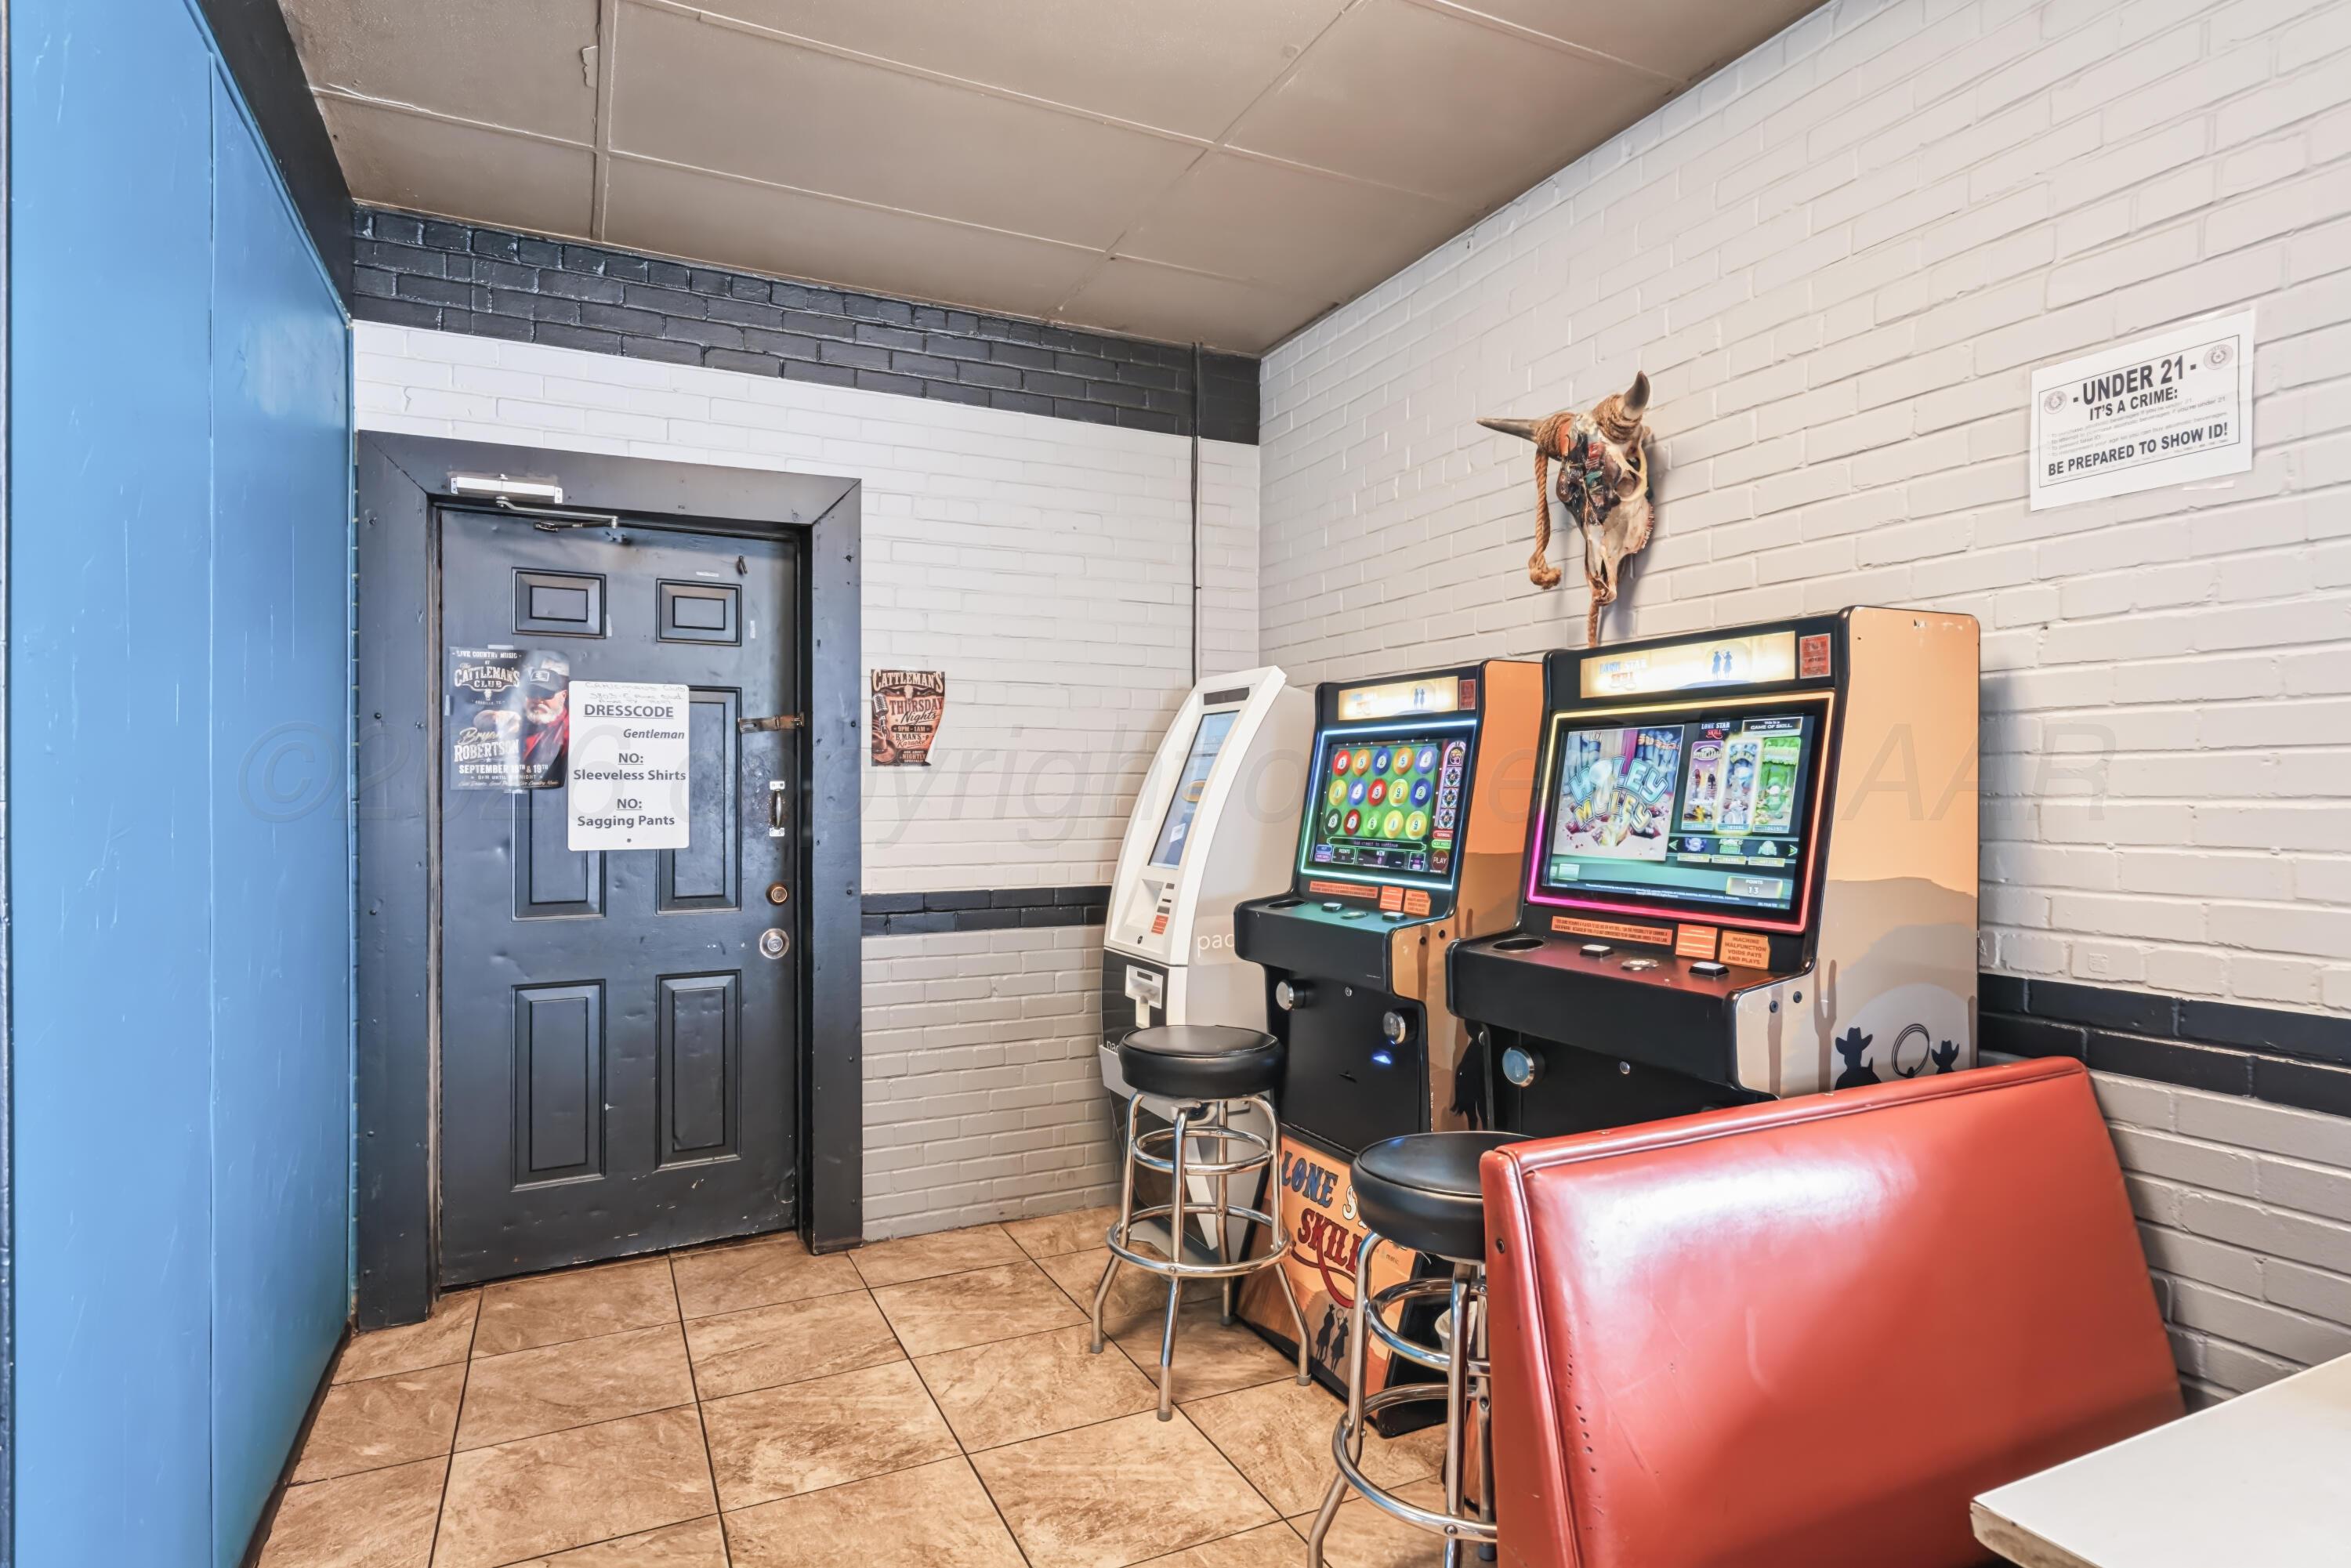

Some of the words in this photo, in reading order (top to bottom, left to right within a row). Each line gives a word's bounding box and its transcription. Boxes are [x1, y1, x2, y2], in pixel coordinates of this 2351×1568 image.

[2082, 364, 2154, 405] UNDER
[2161, 355, 2183, 384] 21
[2090, 404, 2113, 420] IT'S
[2117, 400, 2125, 413] A
[2130, 386, 2178, 410] CRIME:
[2049, 461, 2064, 476] BE
[2068, 444, 2135, 472] PREPARED
[2139, 439, 2157, 454] TO
[2161, 428, 2204, 450] SHOW
[2208, 422, 2227, 439] ID!
[454, 666, 520, 687] CATTLEMAN'S
[872, 669, 944, 693] CATTLEMAN'S
[584, 704, 674, 718] DRESSCODE
[889, 697, 944, 715] THURSDAY
[900, 711, 940, 725] Nights
[623, 729, 685, 739] Gentleman
[454, 739, 519, 762] ROBERTSON
[618, 753, 644, 763] NO:
[459, 764, 509, 773] SEPTEMBER
[526, 765, 531, 773] &
[533, 764, 549, 773] 19TH
[574, 770, 644, 780] Sleeveless
[647, 770, 686, 780] Shirts
[617, 798, 643, 809] NO:
[578, 816, 634, 829] Sagging
[639, 815, 676, 826] Pants
[1197, 933, 1234, 958] pac
[1725, 942, 1766, 952] MALFUNCTION
[1281, 1150, 1339, 1208] LONE
